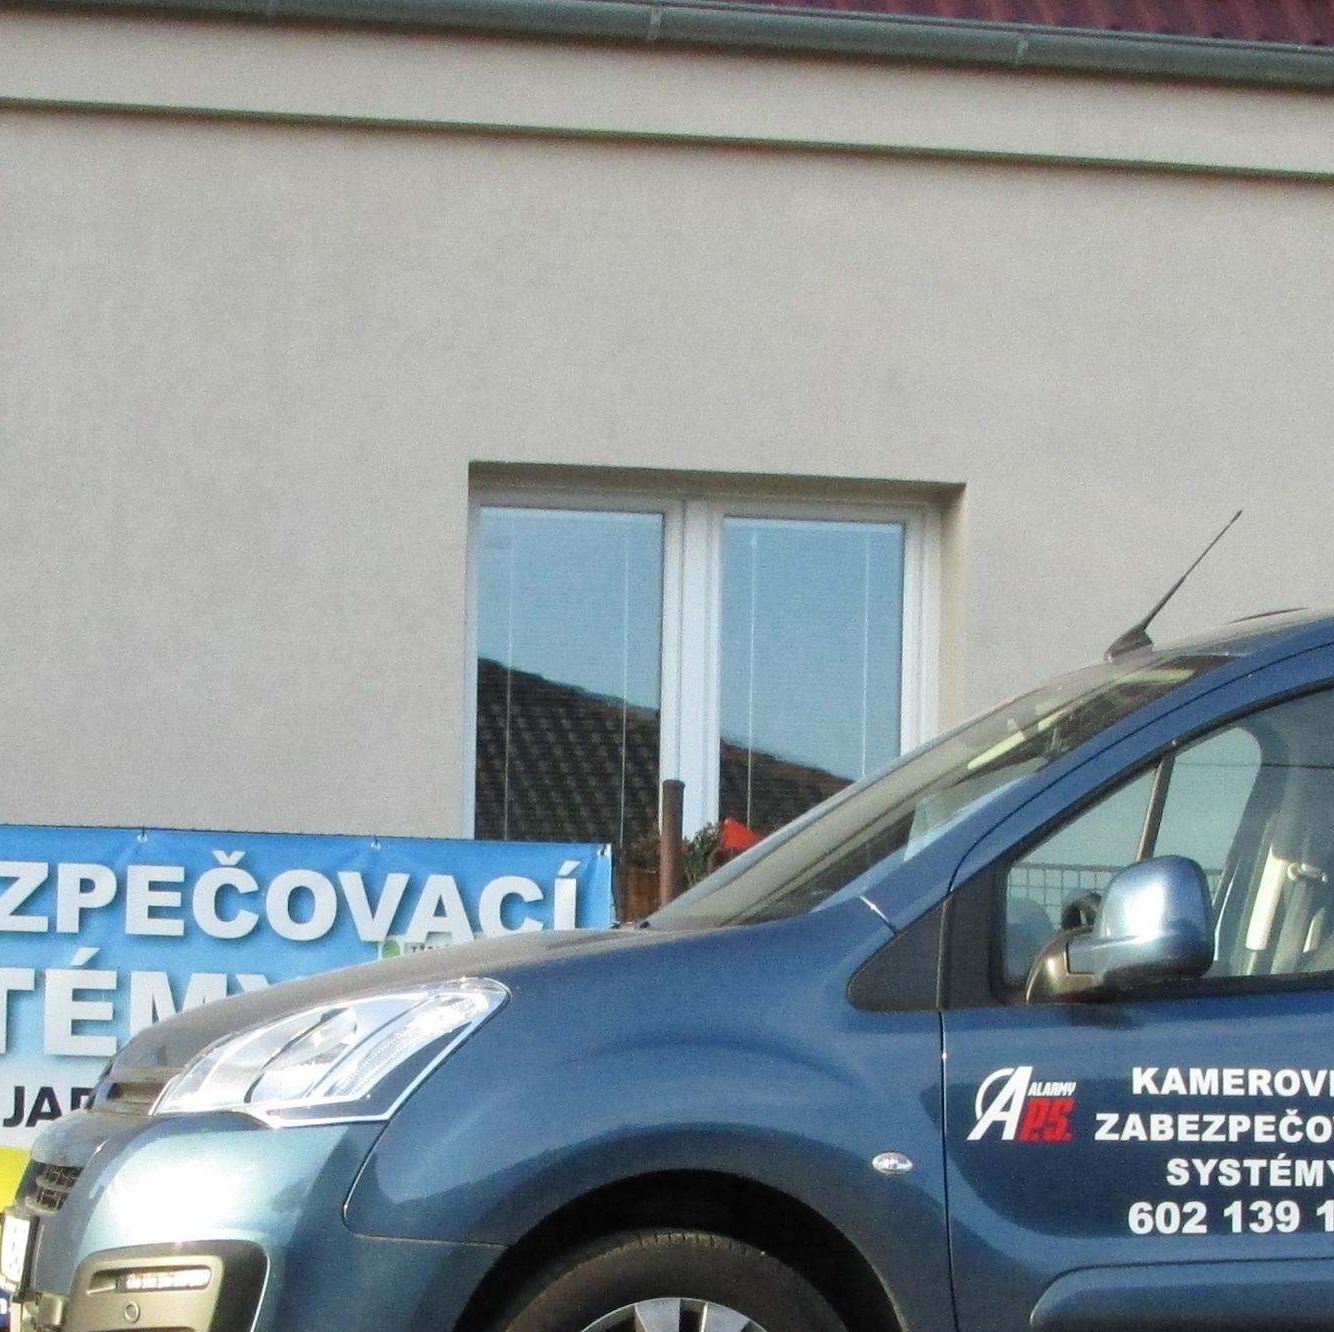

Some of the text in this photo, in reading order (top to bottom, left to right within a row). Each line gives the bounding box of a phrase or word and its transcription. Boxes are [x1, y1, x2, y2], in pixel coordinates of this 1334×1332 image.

[1028, 1082, 1076, 1096] ALARMY
[1128, 1202, 1207, 1234] 602
[1223, 1200, 1300, 1233] 139
